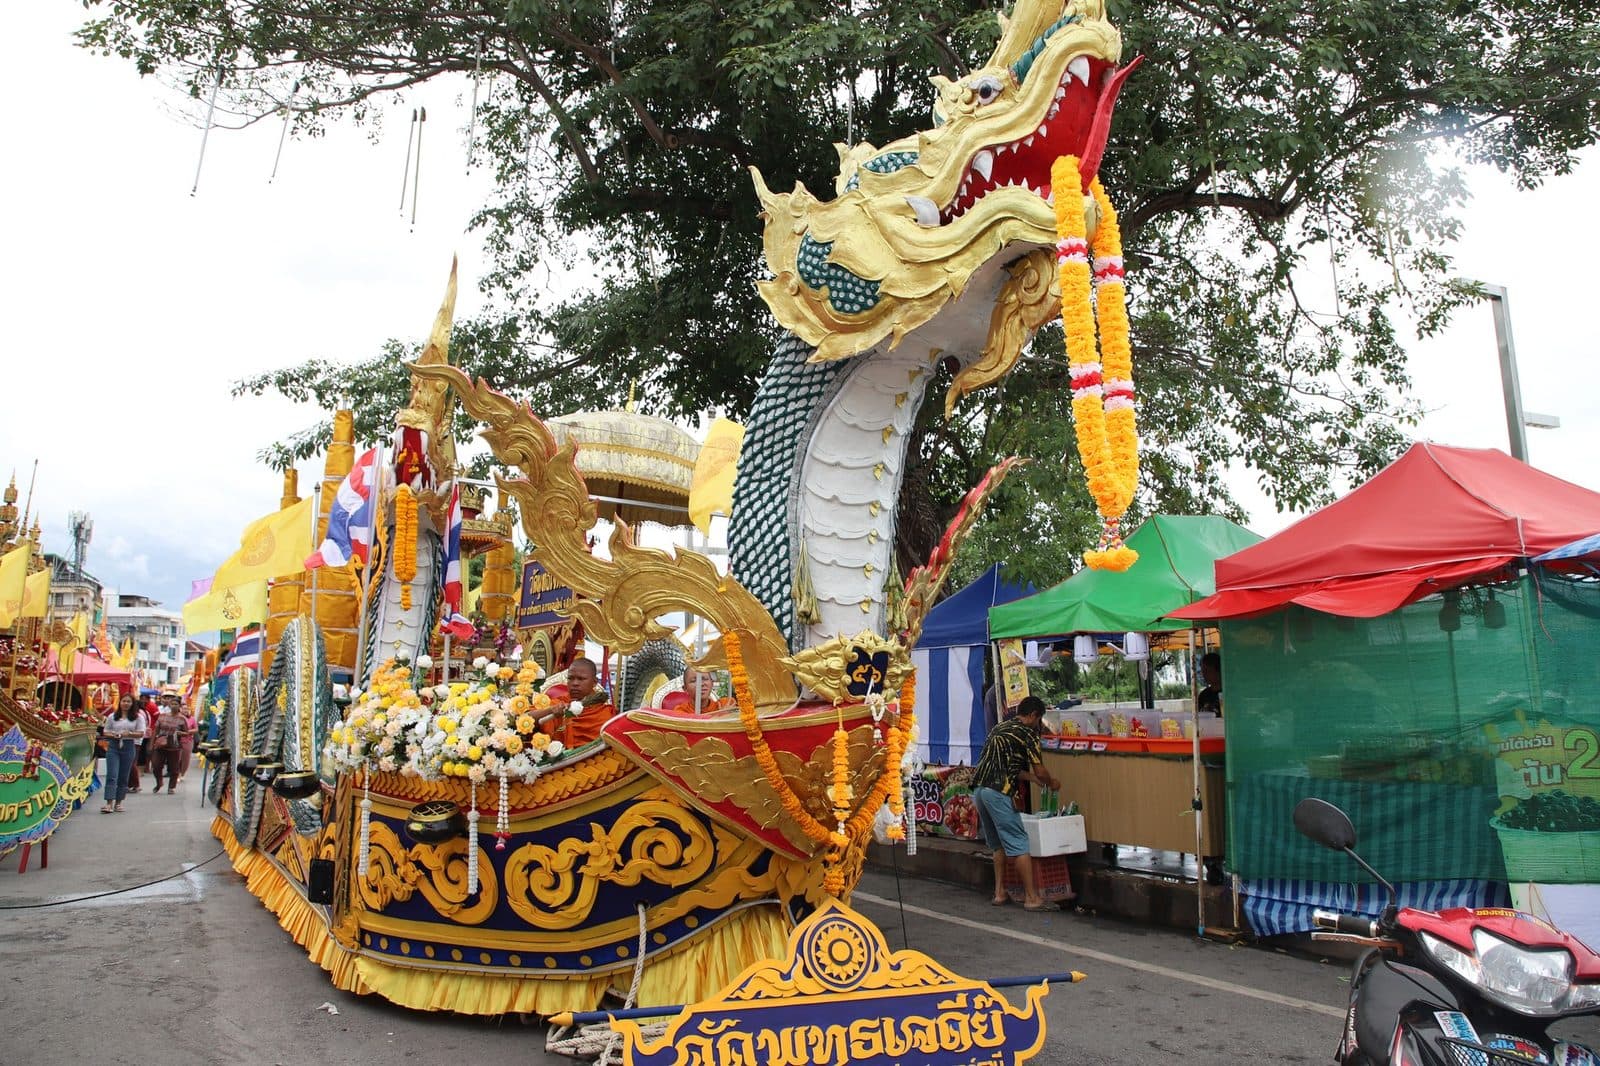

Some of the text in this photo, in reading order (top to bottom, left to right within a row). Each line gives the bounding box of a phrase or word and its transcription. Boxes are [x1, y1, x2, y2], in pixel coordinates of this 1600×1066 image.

[673, 992, 1008, 1066] วัดพทธเจดีย์
